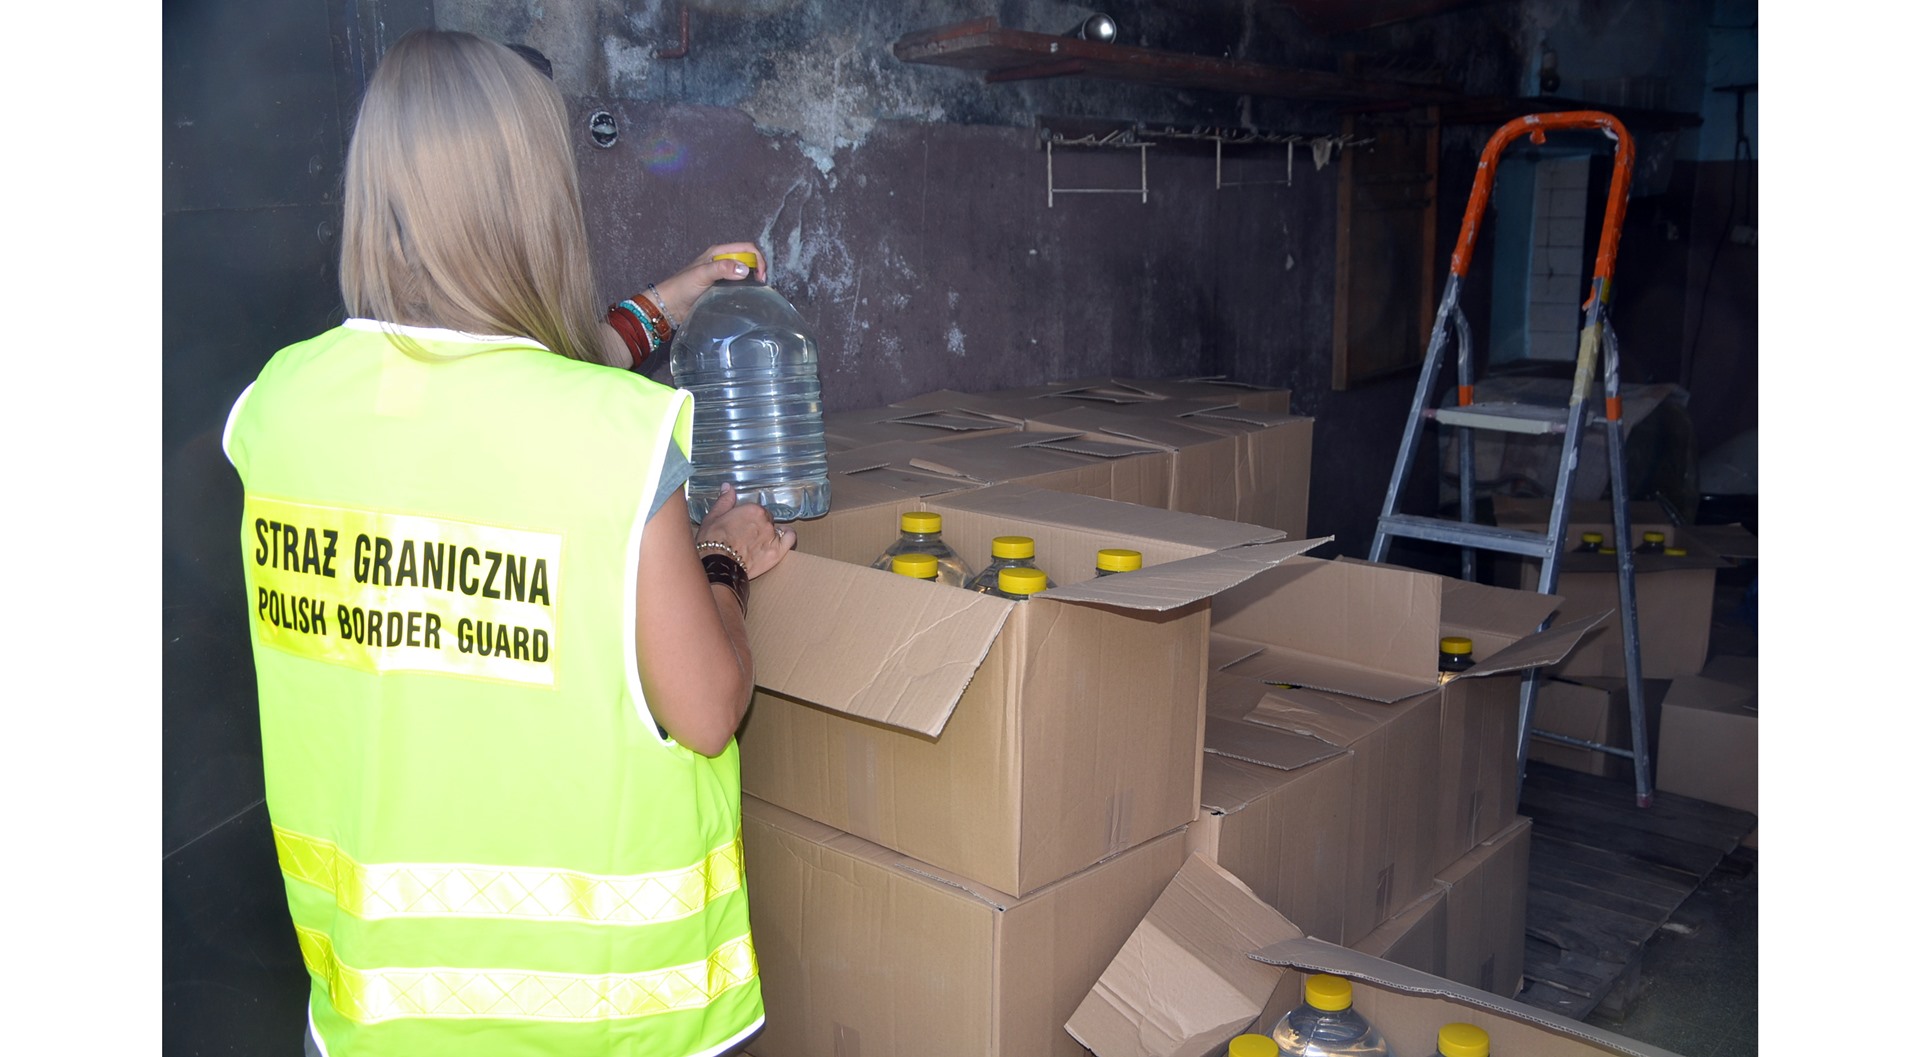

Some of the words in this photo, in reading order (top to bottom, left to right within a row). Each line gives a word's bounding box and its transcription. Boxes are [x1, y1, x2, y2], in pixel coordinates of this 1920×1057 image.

[353, 533, 551, 606] GRANICZNA
[258, 586, 327, 635] POLISH
[337, 604, 441, 649] BORDER
[457, 618, 549, 663] GUARD
